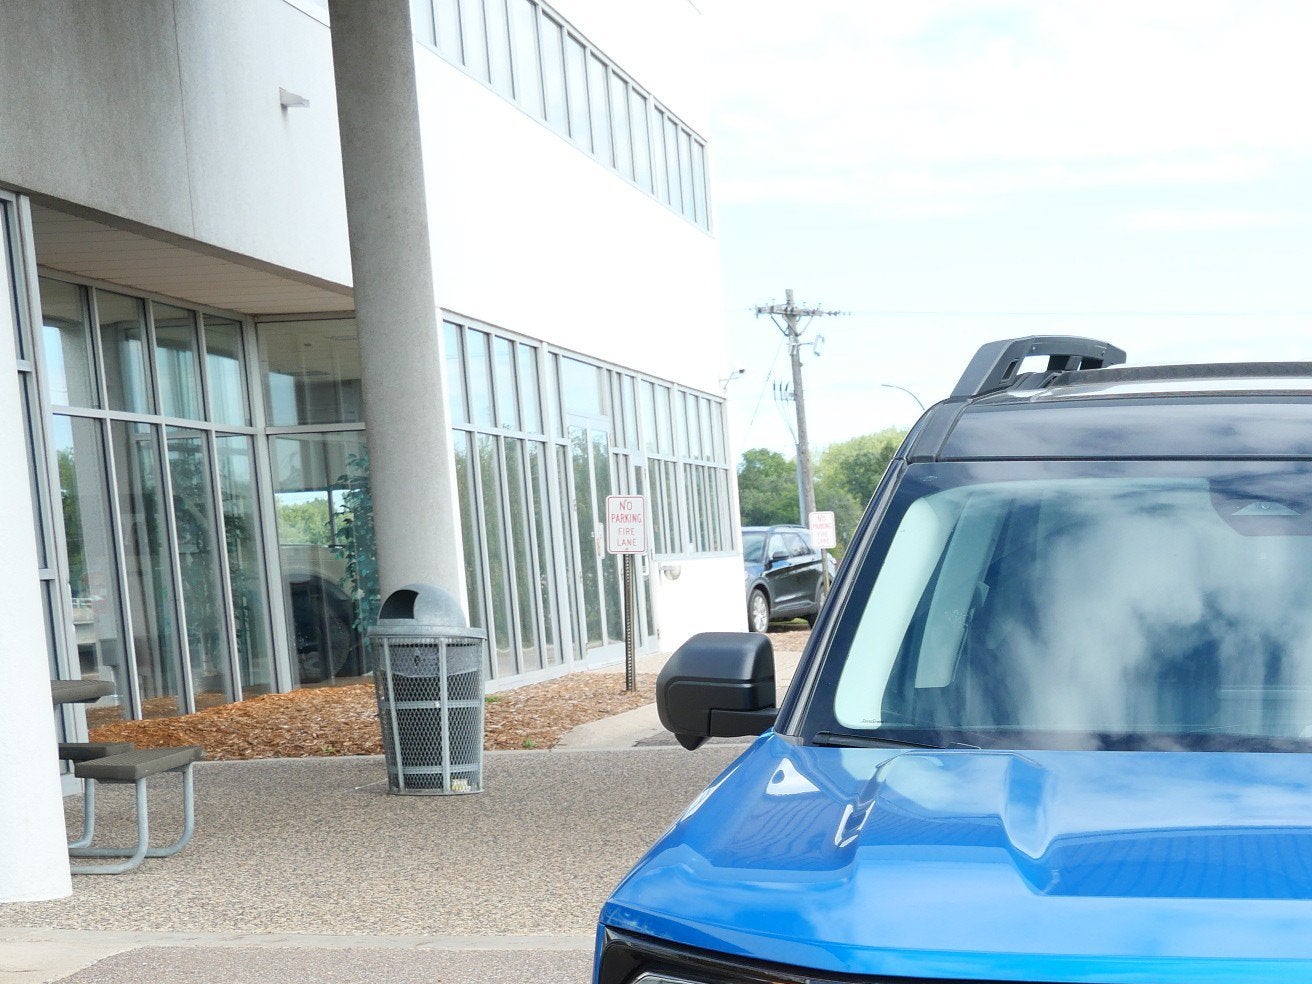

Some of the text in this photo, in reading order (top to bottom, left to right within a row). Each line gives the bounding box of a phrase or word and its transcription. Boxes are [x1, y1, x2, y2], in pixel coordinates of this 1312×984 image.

[619, 501, 633, 511] NO
[611, 513, 642, 523] PARKING
[618, 527, 636, 536] FIRE
[617, 538, 637, 547] LANE
